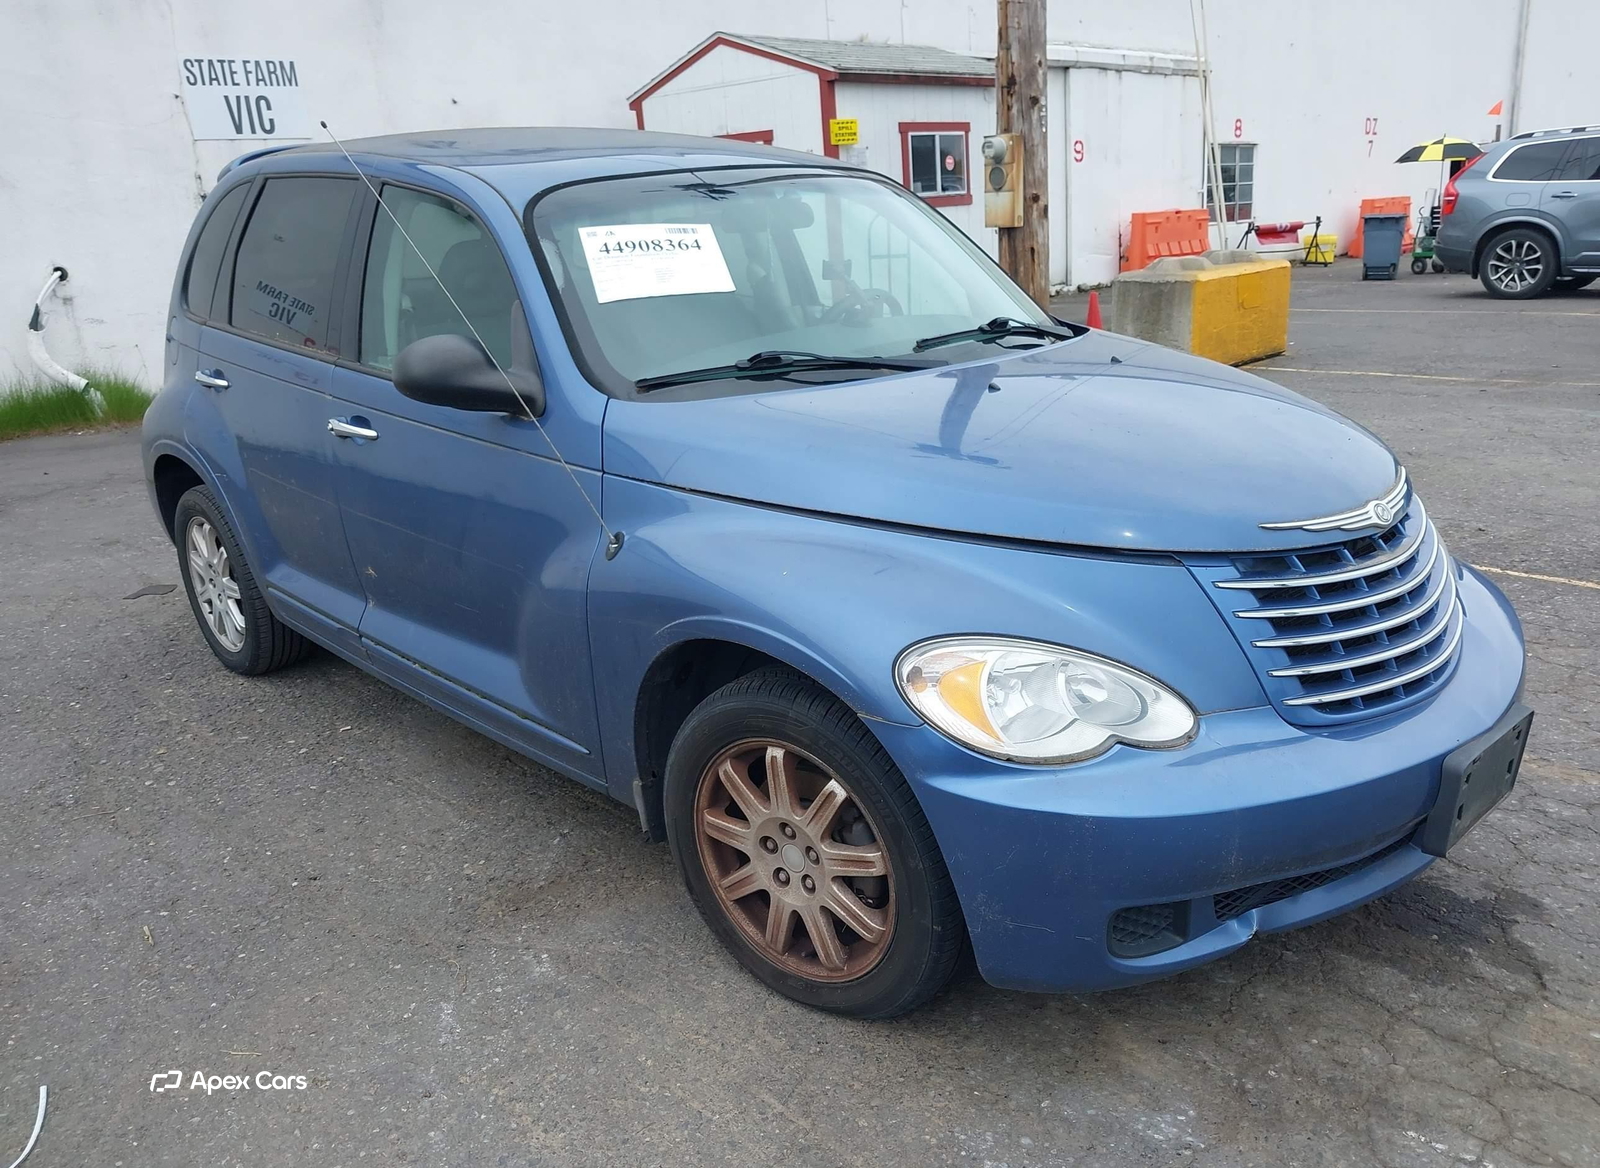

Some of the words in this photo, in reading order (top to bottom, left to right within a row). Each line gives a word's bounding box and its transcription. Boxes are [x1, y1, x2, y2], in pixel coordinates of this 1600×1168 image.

[183, 58, 241, 87] STATE
[242, 59, 299, 88] FARM
[223, 94, 276, 135] VIC
[1234, 118, 1242, 138] 8
[1073, 140, 1084, 163] 9
[1368, 140, 1374, 158] 7
[599, 238, 702, 254] 44908364
